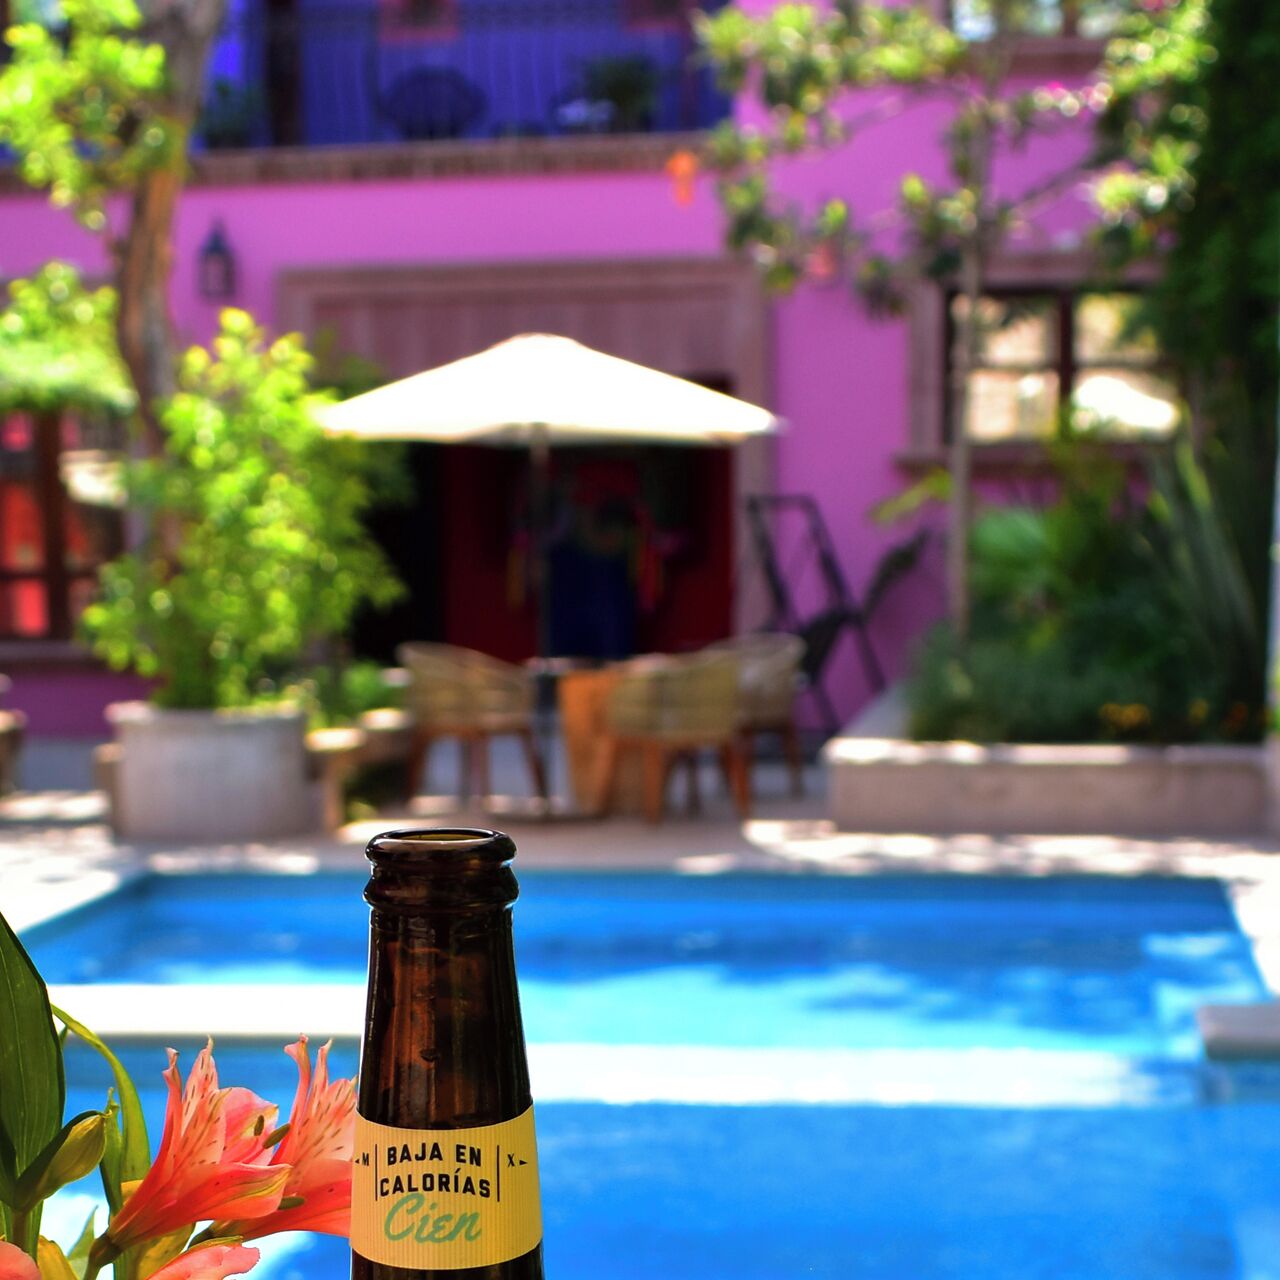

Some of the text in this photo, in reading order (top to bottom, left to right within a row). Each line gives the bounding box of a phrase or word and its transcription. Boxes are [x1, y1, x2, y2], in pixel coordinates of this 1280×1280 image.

[387, 1142, 482, 1167] BAJA EN
[380, 1168, 491, 1198] CALORÍAS
[384, 1193, 482, 1244] Cien
